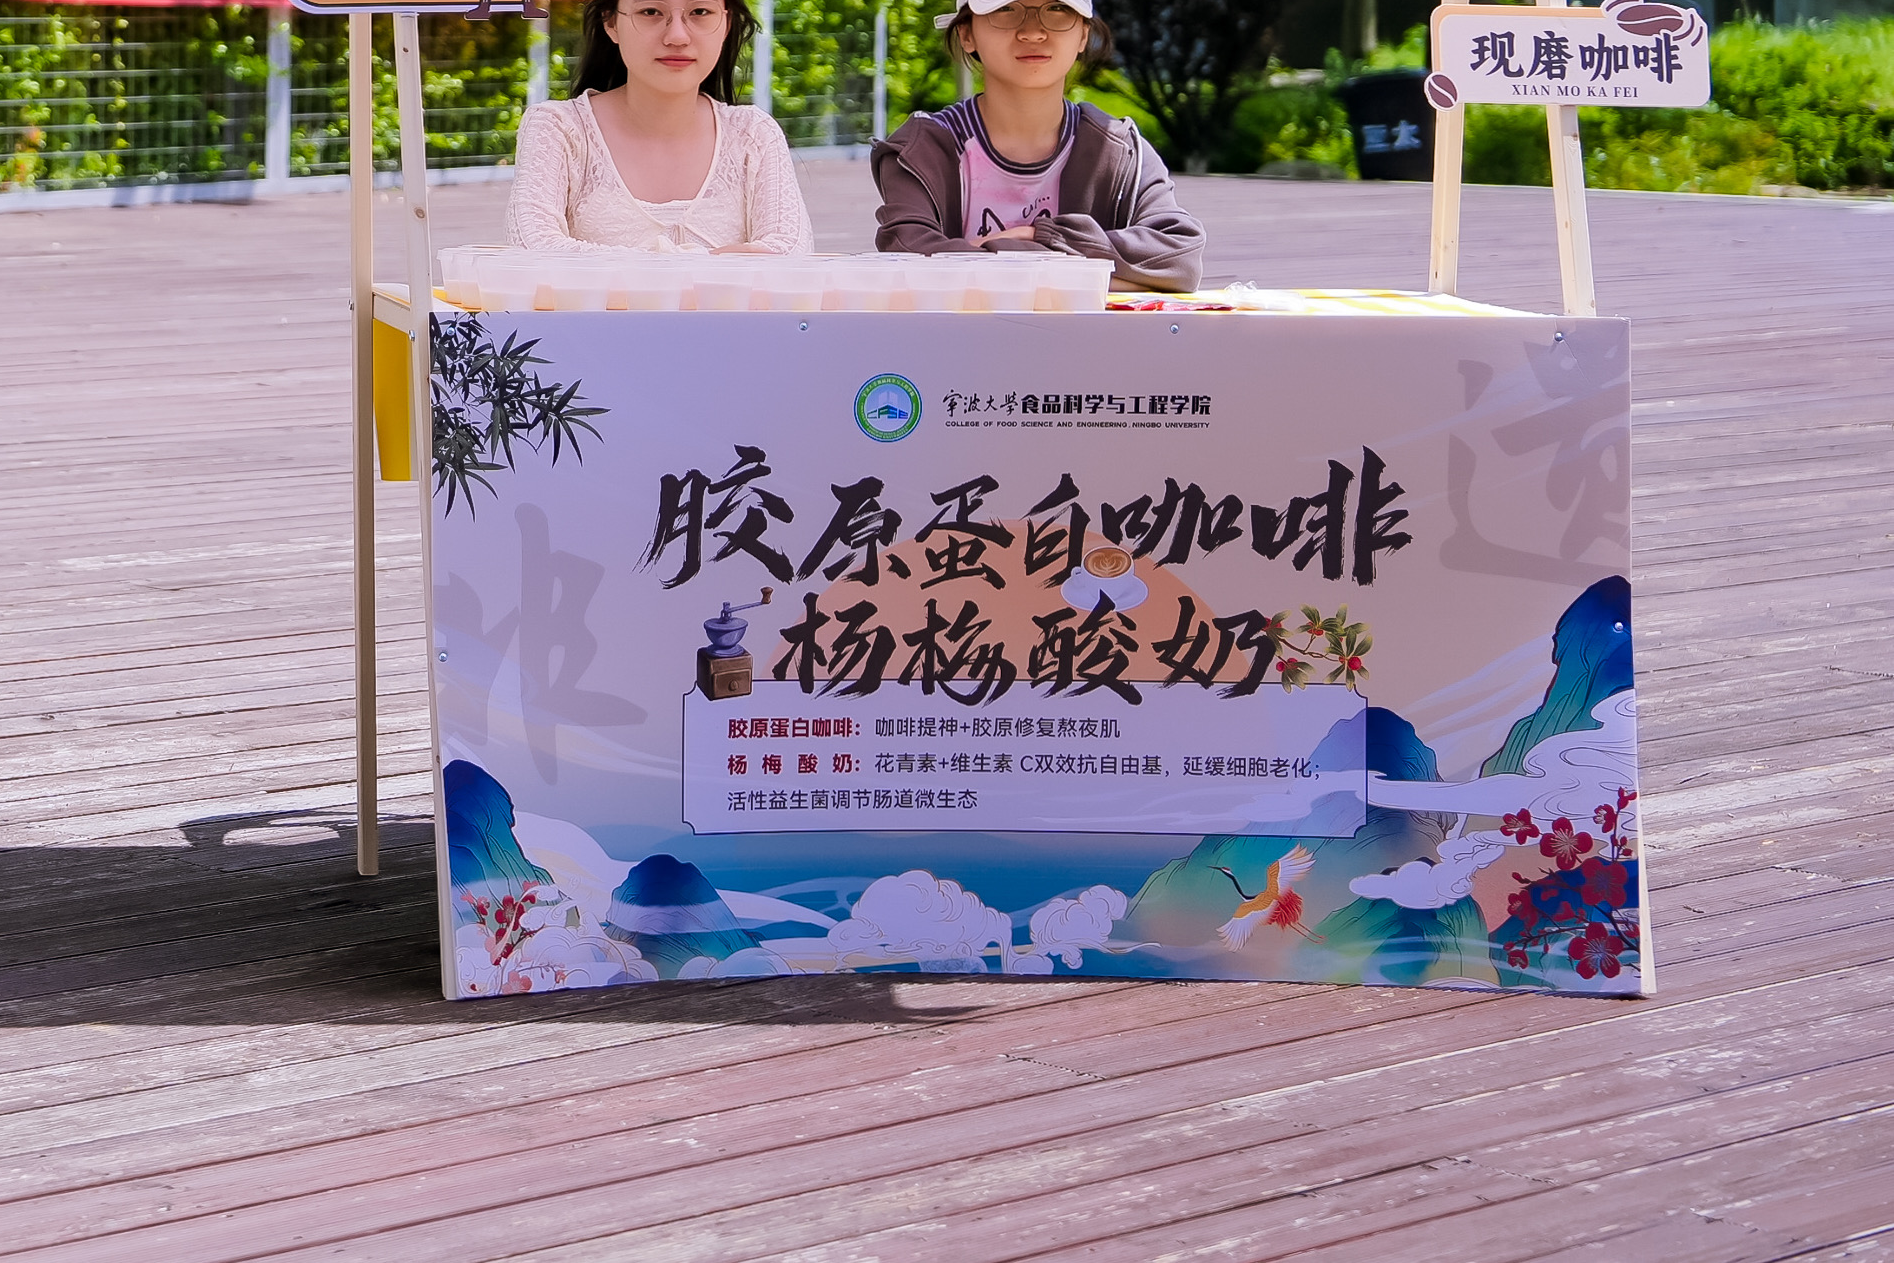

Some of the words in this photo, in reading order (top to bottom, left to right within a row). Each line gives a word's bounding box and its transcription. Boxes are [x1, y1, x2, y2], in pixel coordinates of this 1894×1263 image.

[1470, 31, 1683, 84] 现磨咖啡
[1511, 84, 1551, 96] XIAN
[1556, 85, 1581, 96] MO
[1586, 86, 1608, 97] KA
[1613, 86, 1639, 98] FEI
[1132, 421, 1162, 429] NINGBO
[638, 444, 1414, 592] 胶原蛋白咖啡
[772, 590, 1278, 706] 杨梅酸奶
[727, 788, 979, 812] 活性益生菌调节肠道微生态
